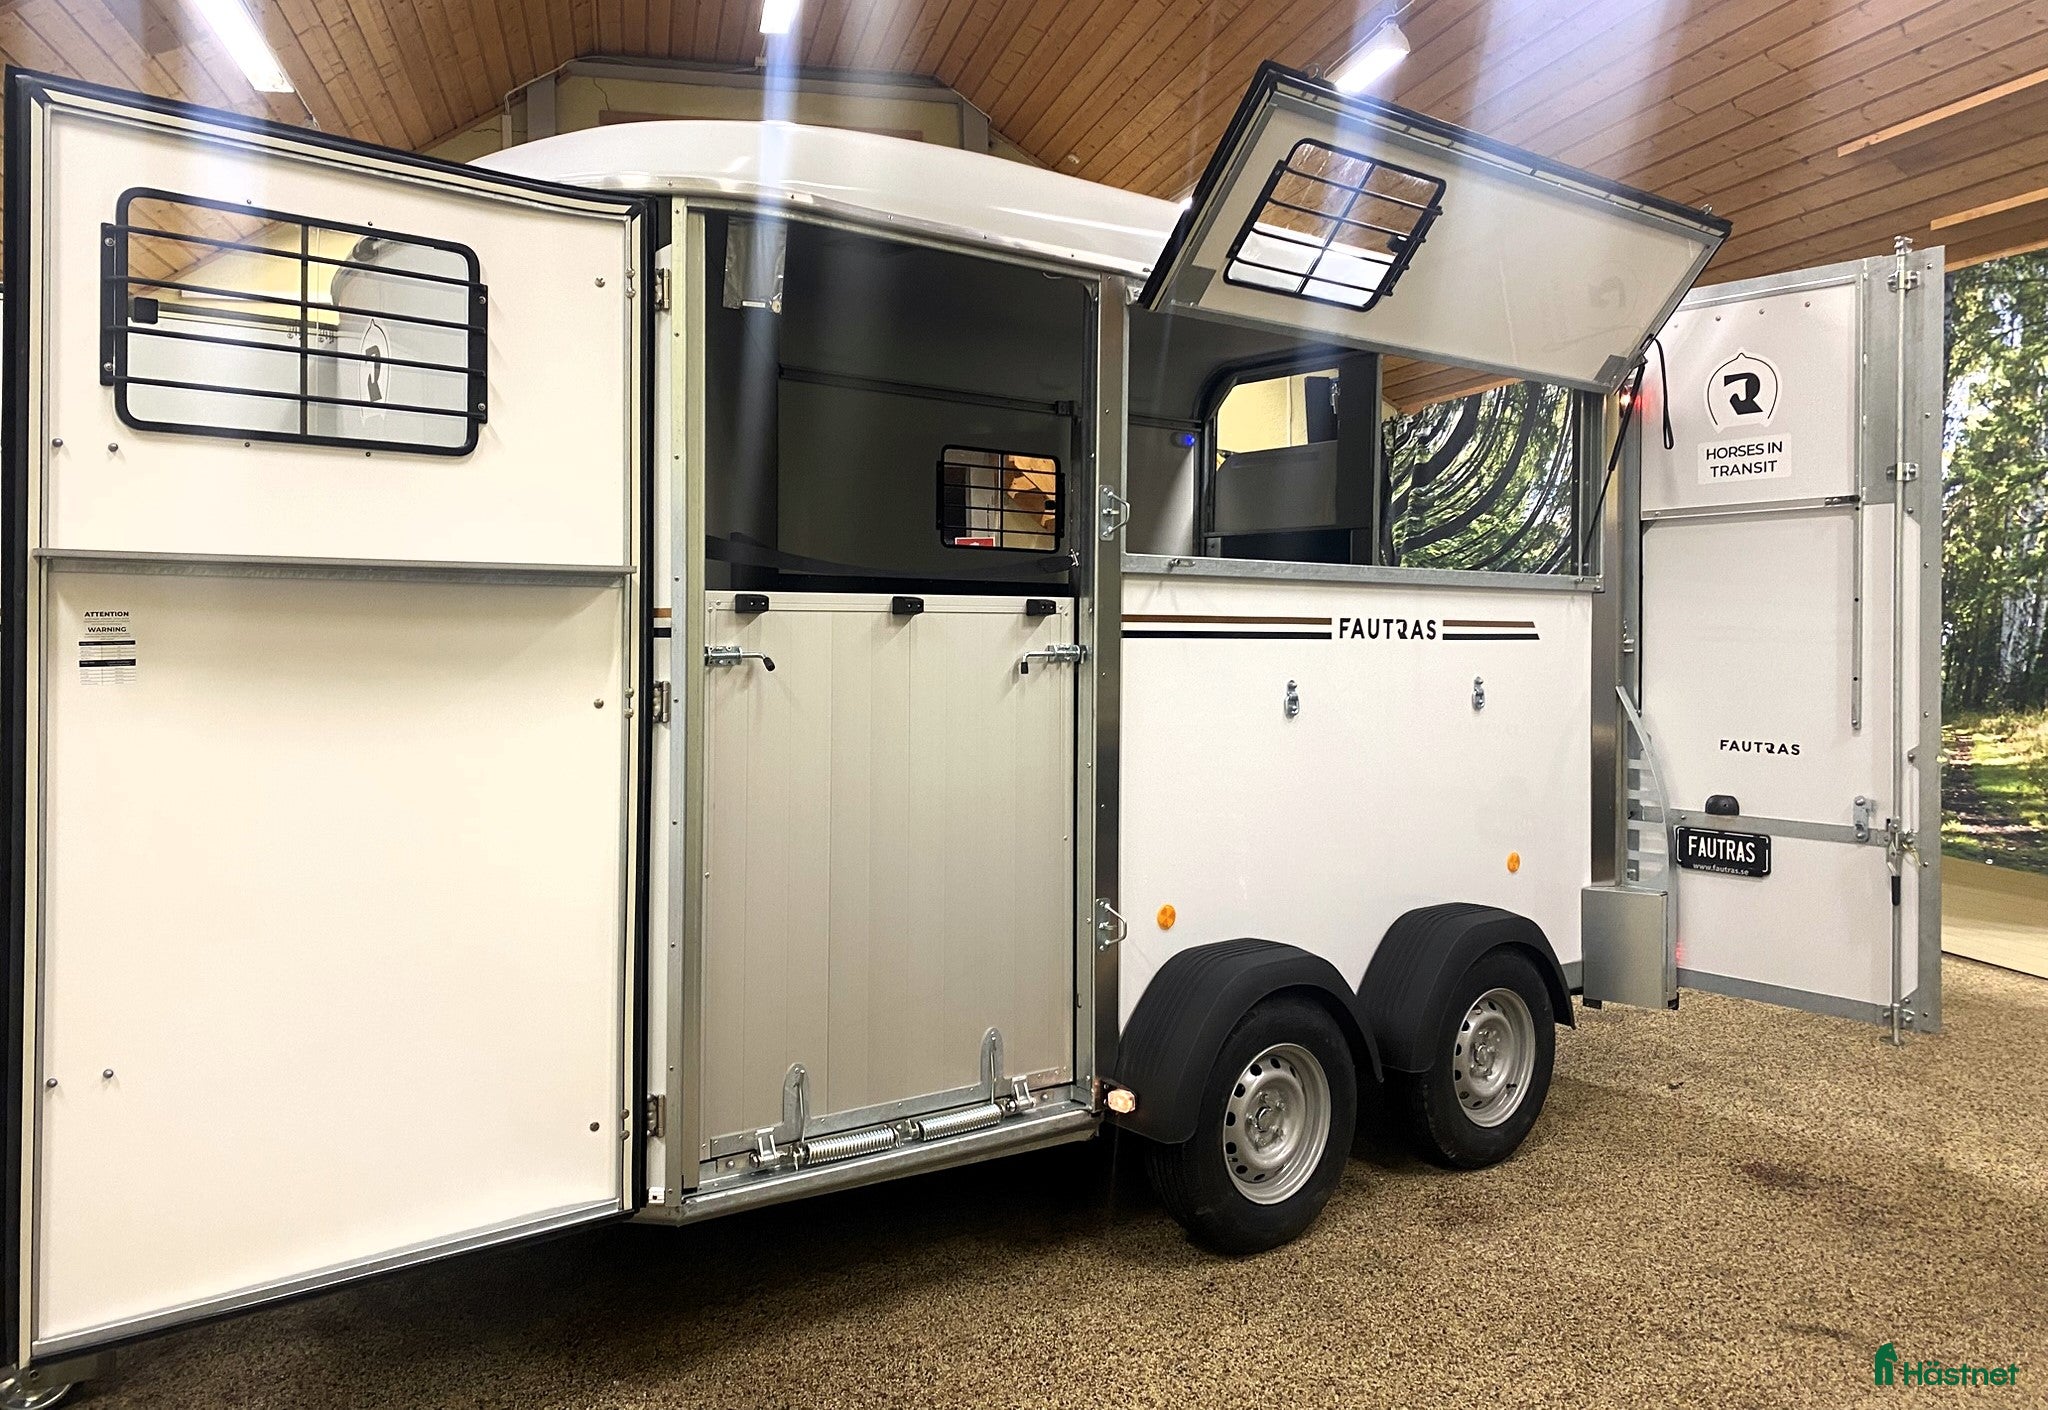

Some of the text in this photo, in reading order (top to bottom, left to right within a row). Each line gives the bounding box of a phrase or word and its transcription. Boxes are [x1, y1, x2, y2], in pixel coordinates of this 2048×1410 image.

[1706, 440, 1783, 460] HORSES IN
[1710, 460, 1777, 477] TRANSIT
[1339, 618, 1436, 640] FAUTRAS
[1720, 739, 1801, 756] FAUTRAS
[1688, 835, 1756, 863] FAUTRAS
[1693, 863, 1750, 876] www.fautras.se
